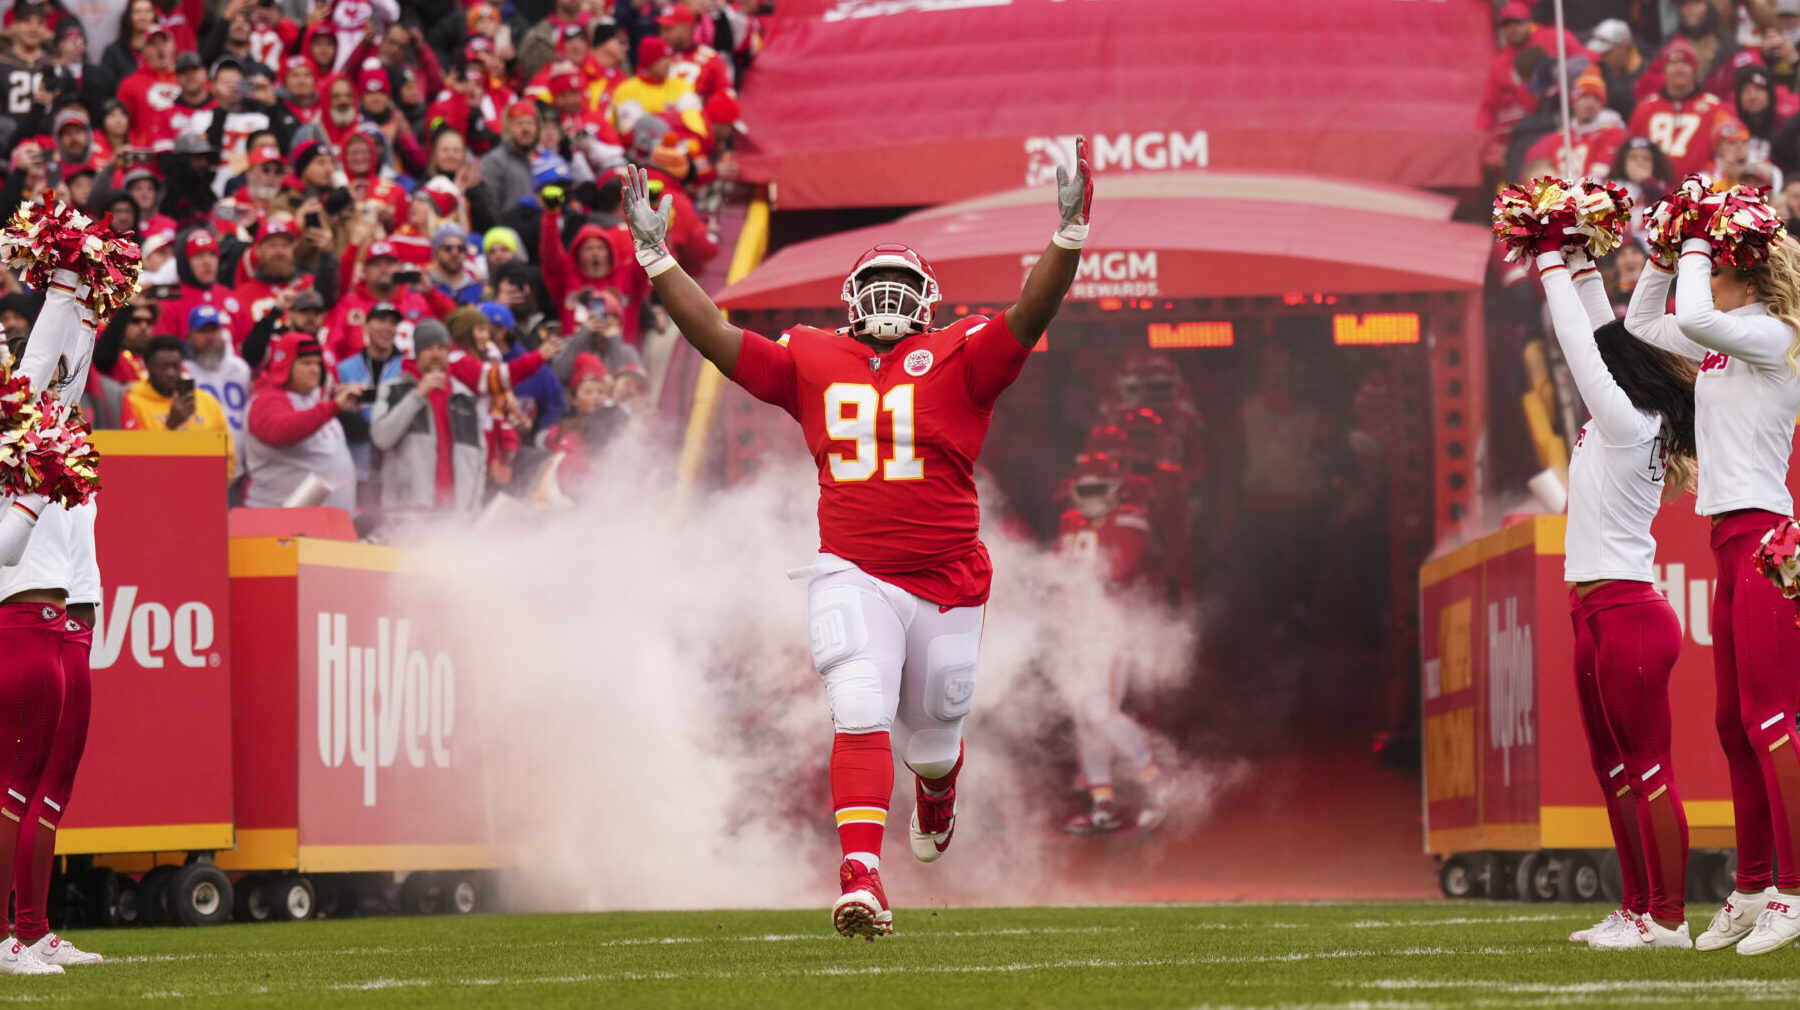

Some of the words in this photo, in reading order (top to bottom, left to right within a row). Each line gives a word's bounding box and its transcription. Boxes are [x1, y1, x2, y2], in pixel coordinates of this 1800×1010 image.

[1093, 131, 1208, 171] MGM
[1074, 251, 1158, 280] MGM
[1073, 281, 1159, 298] REWARDS
[824, 382, 924, 482] 91
